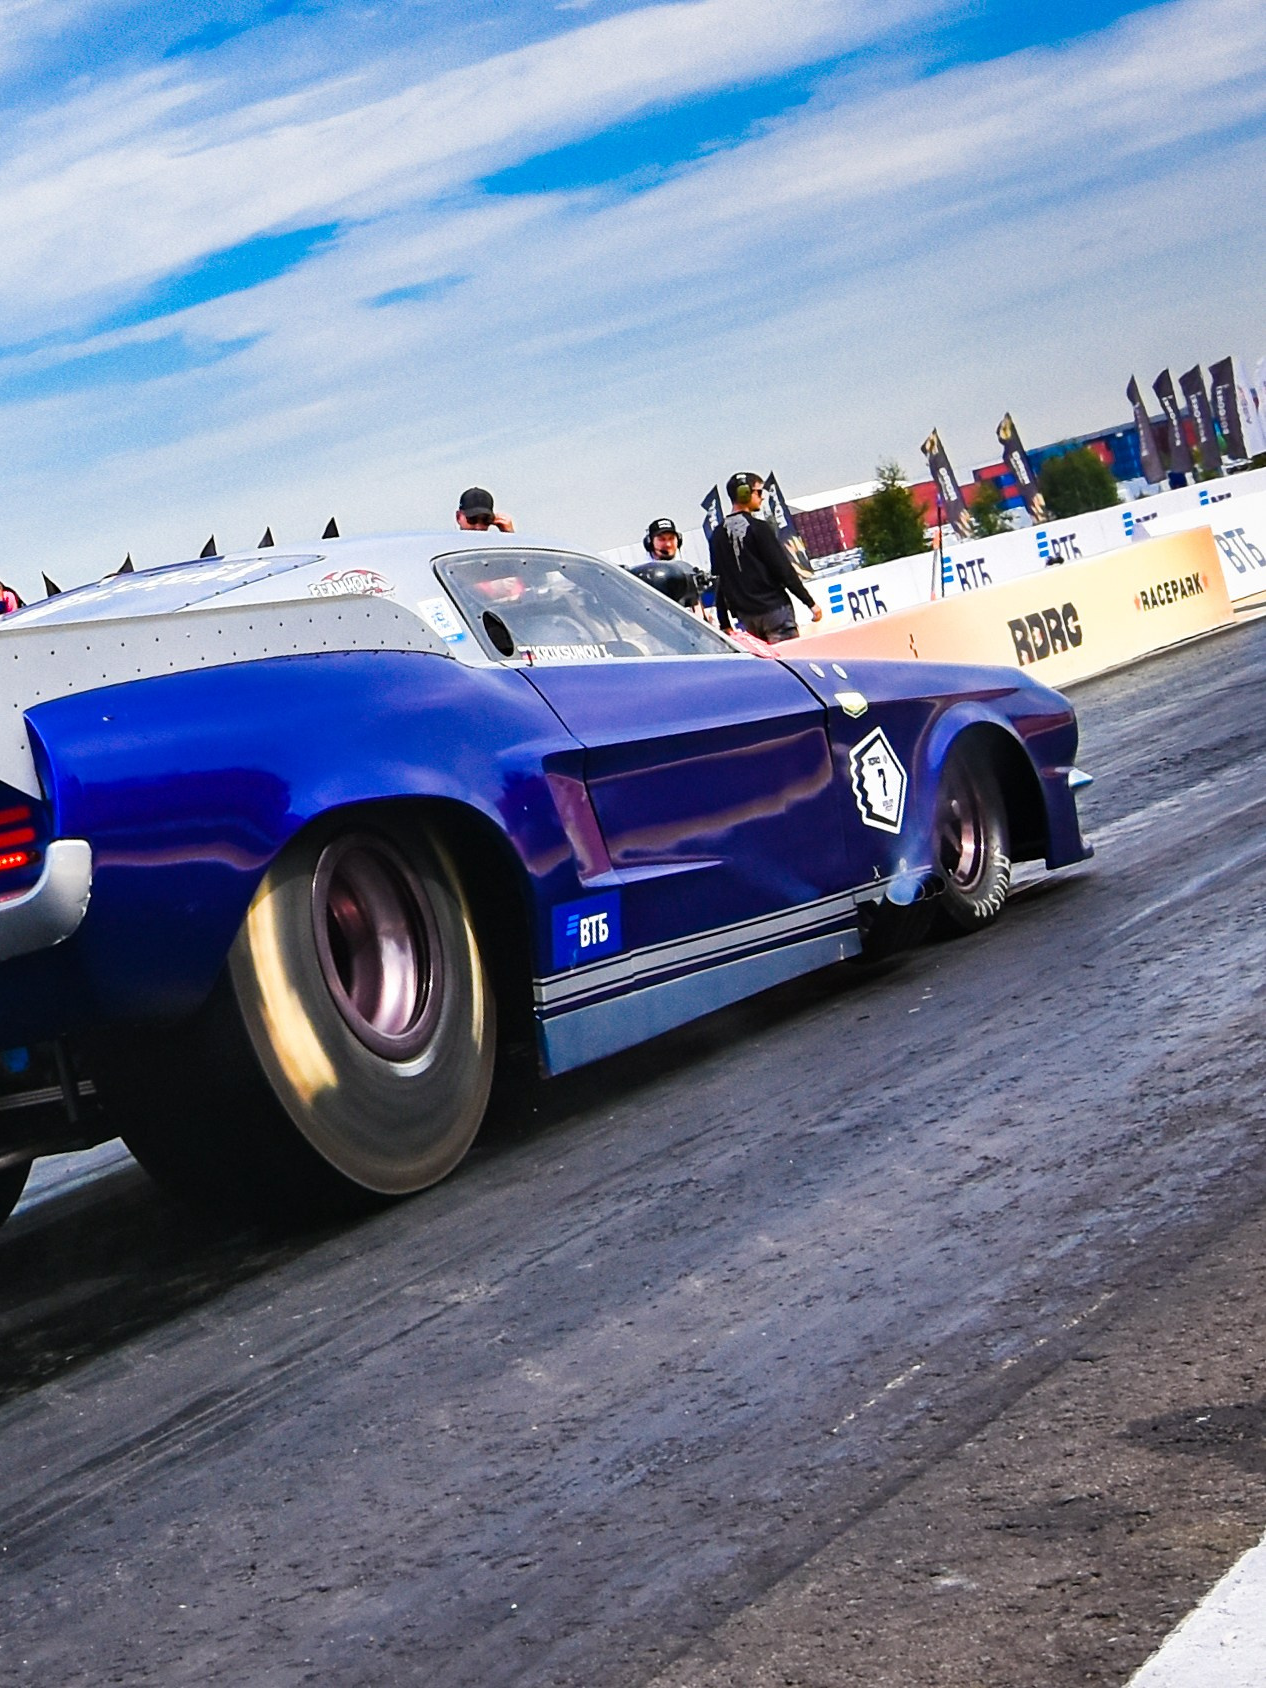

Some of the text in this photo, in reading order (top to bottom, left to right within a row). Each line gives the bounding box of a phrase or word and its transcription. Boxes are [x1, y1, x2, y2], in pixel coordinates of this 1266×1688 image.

[1214, 527, 1266, 573] ВТБ
[1140, 572, 1204, 611] RACEPARK
[1007, 602, 1083, 667] RDRC
[877, 768, 888, 796] 7
[580, 912, 609, 948] ВТБ
